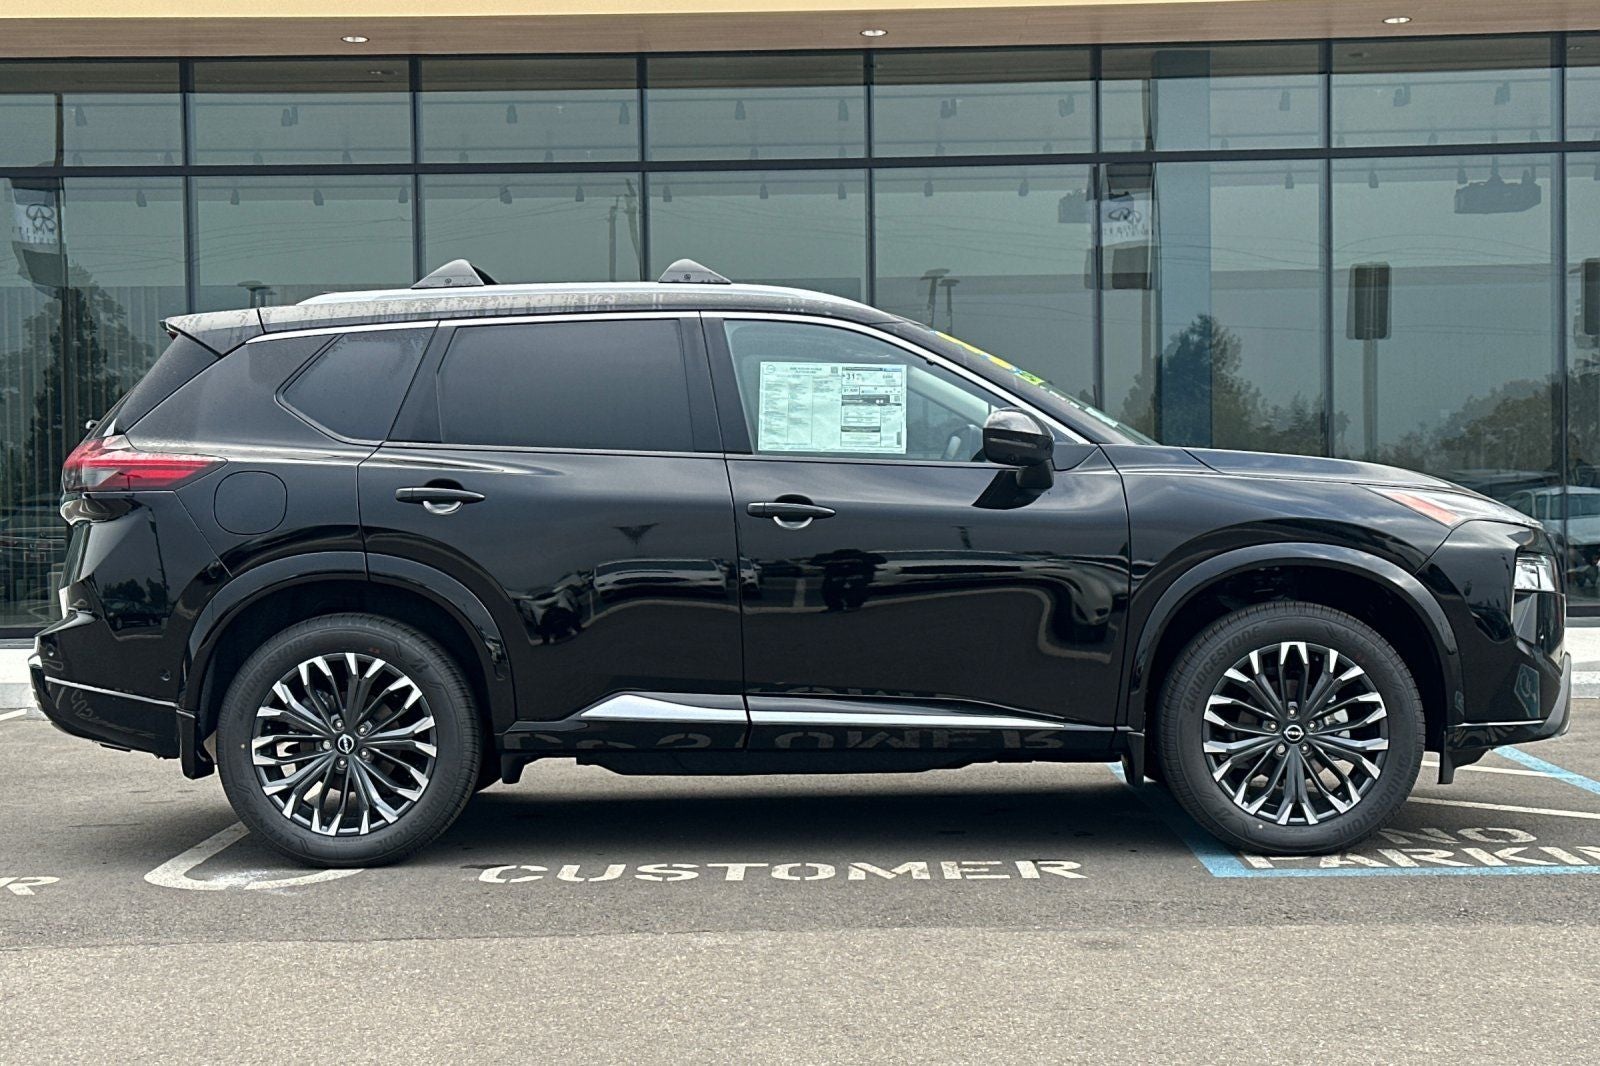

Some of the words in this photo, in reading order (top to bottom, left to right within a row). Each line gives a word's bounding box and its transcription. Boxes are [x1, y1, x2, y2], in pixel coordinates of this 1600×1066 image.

[1183, 626, 1261, 713] BRIDGESTONE
[1333, 755, 1412, 841] BRIDGESTONE
[1378, 827, 1537, 844] NO
[479, 860, 1088, 883] CUSTOMER
